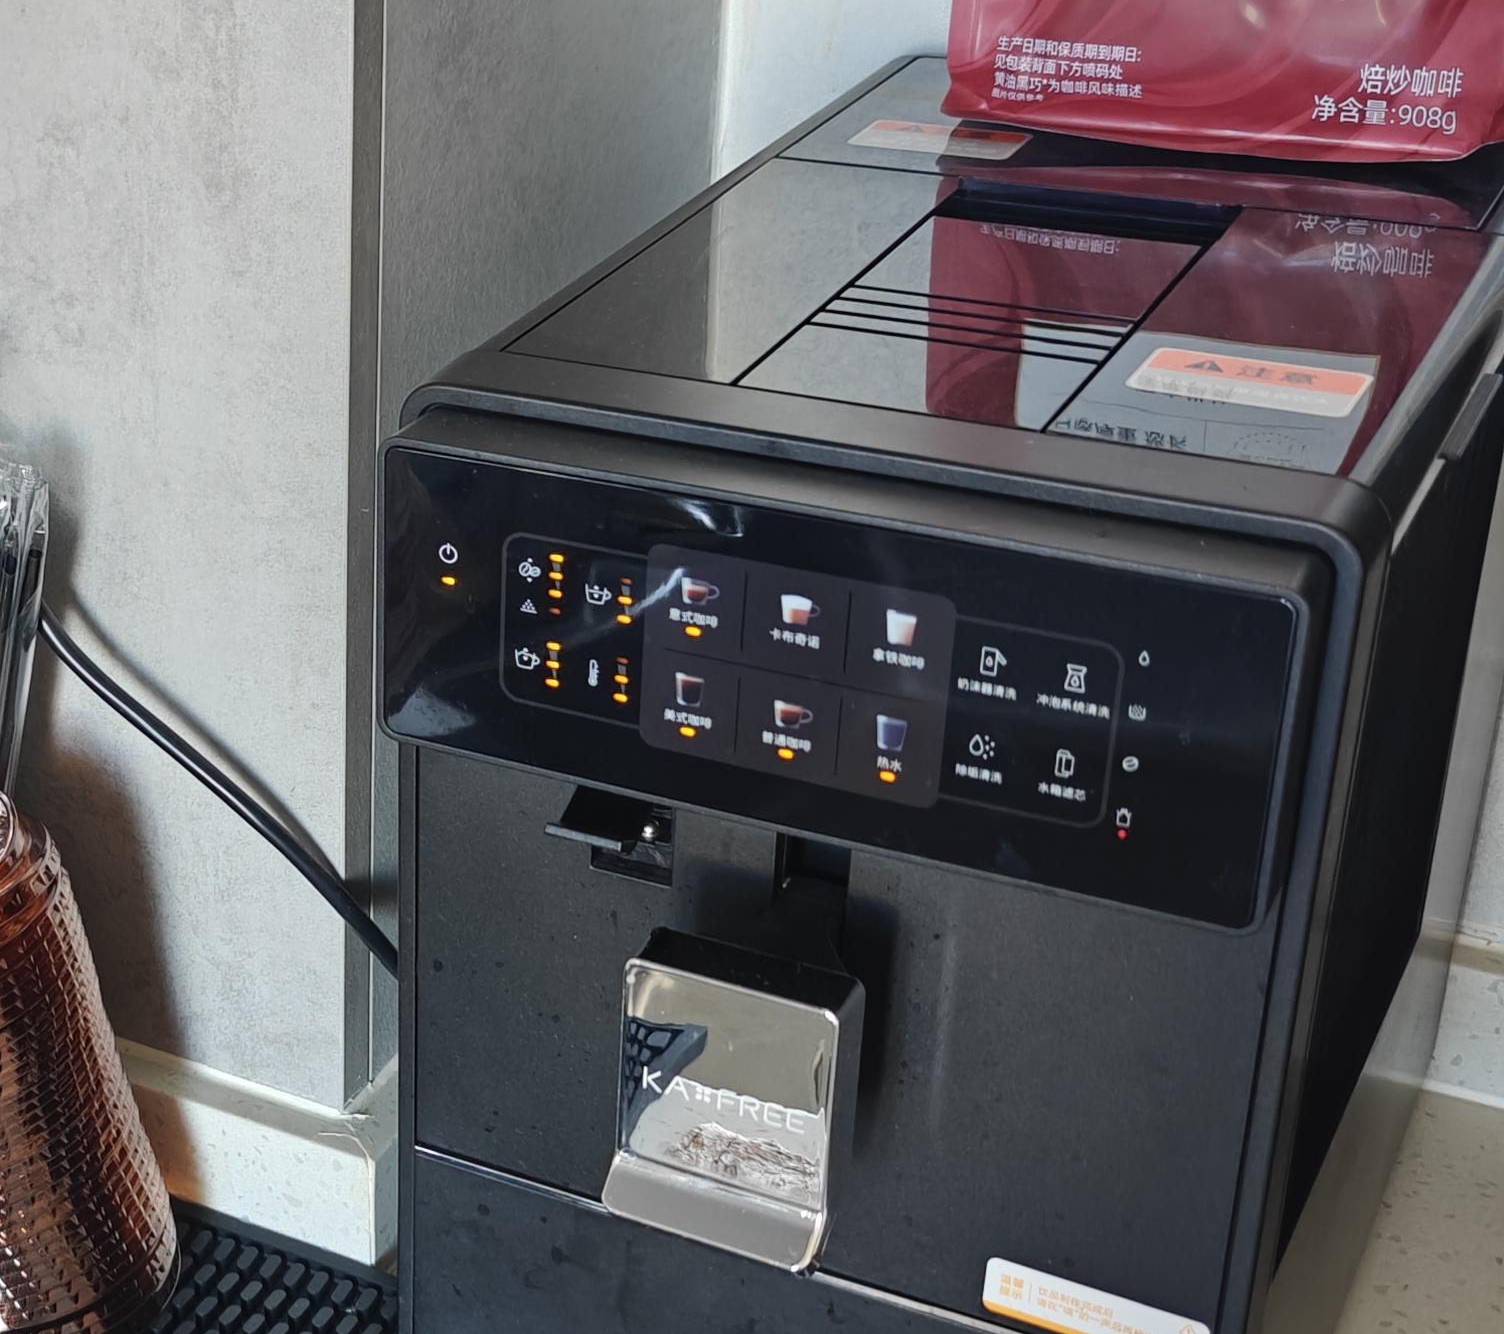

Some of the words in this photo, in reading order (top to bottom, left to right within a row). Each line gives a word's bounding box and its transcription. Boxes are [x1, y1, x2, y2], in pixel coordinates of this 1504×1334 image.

[996, 35, 1142, 63] 生产日期和保质期到期日:
[993, 54, 1124, 80] 见包装背面下方喷码处
[1357, 63, 1464, 99] 焙炒咖啡
[1311, 94, 1458, 136] 净含量:908g
[669, 607, 719, 629] 意式咖啡
[769, 628, 821, 650] 卡布奇诺
[872, 648, 925, 670] 拿铁咖啡
[1036, 692, 1111, 720] 冲泡系统清洗
[663, 707, 713, 730] 美式咖啡
[761, 730, 812, 753] 普通咖啡
[876, 755, 903, 773] 热水
[954, 763, 1003, 786] 除垢清洗
[1037, 781, 1087, 803] 水箱滤芯
